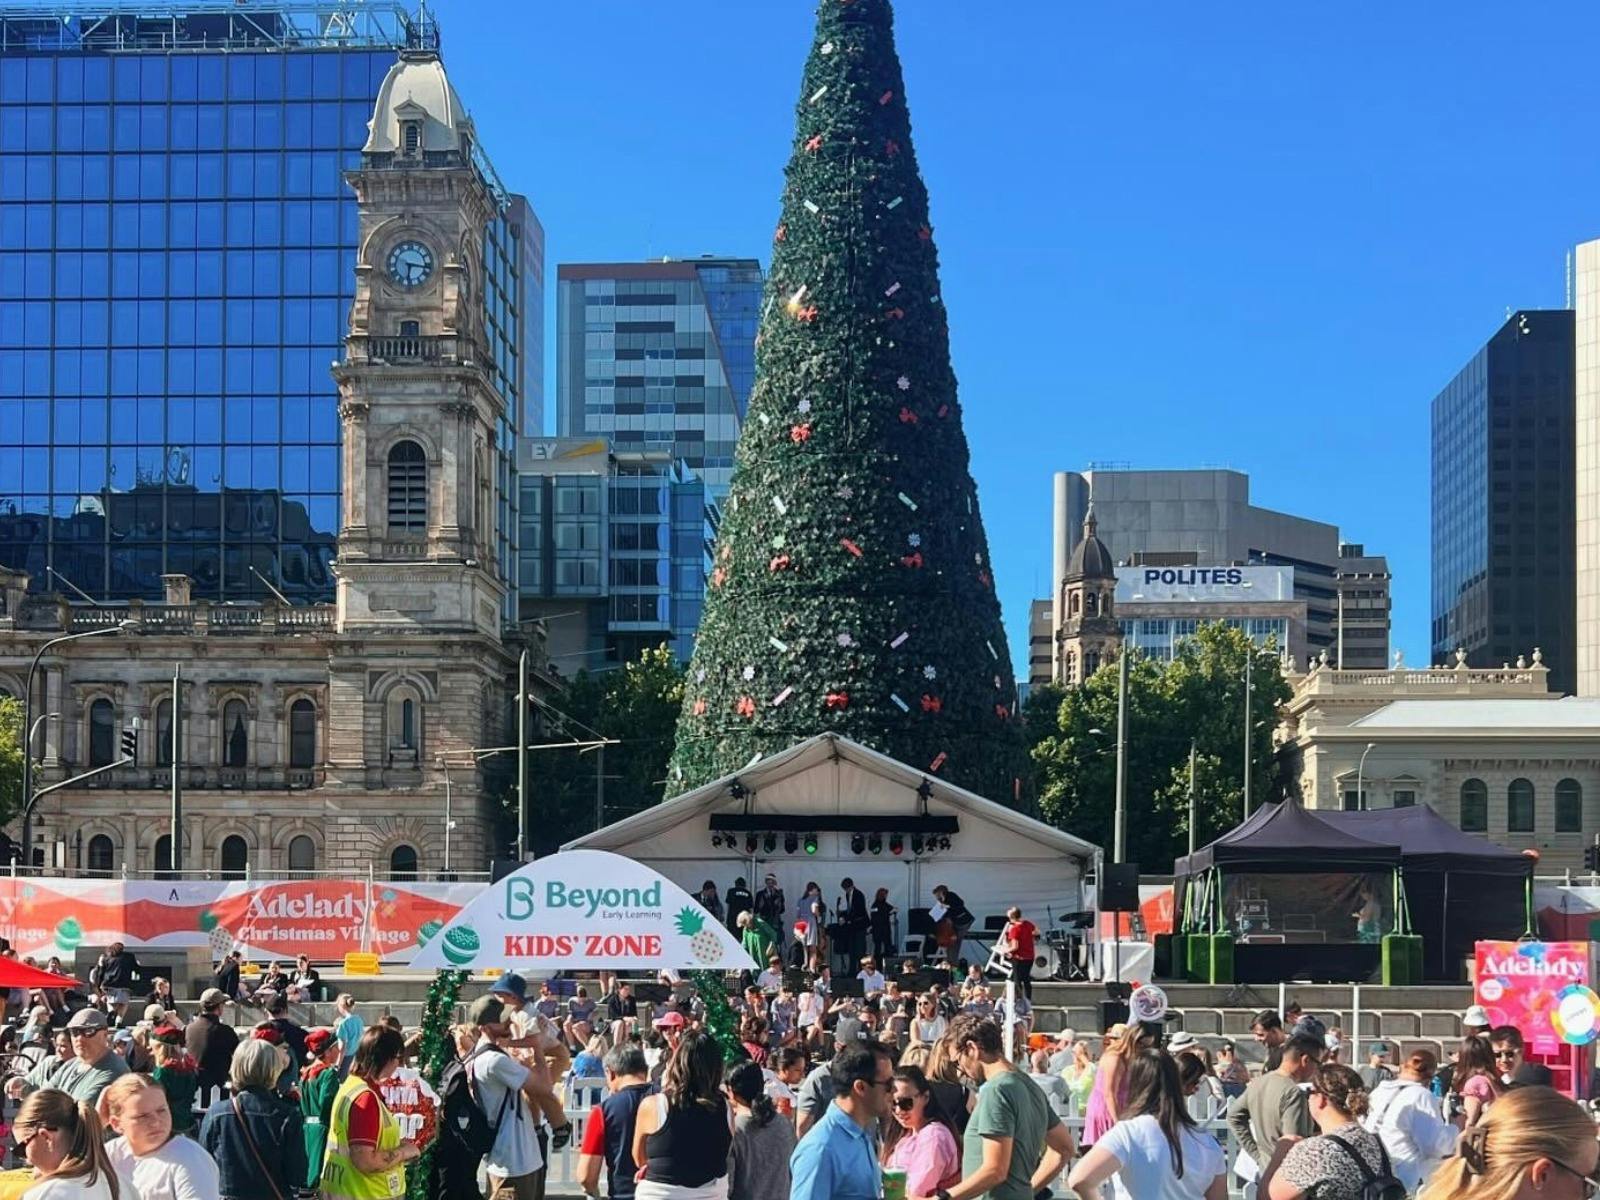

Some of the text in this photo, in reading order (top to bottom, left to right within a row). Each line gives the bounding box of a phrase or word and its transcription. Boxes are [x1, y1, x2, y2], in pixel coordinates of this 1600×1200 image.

[532, 443, 557, 460] EY
[1145, 569, 1242, 585] POLITES
[245, 892, 379, 924] Adelady
[546, 881, 661, 918] Beyond
[602, 911, 661, 920] Early Learning
[238, 925, 336, 942] Christmas
[504, 935, 661, 956] KIDS' ZONE
[1481, 956, 1584, 980] Adelady
